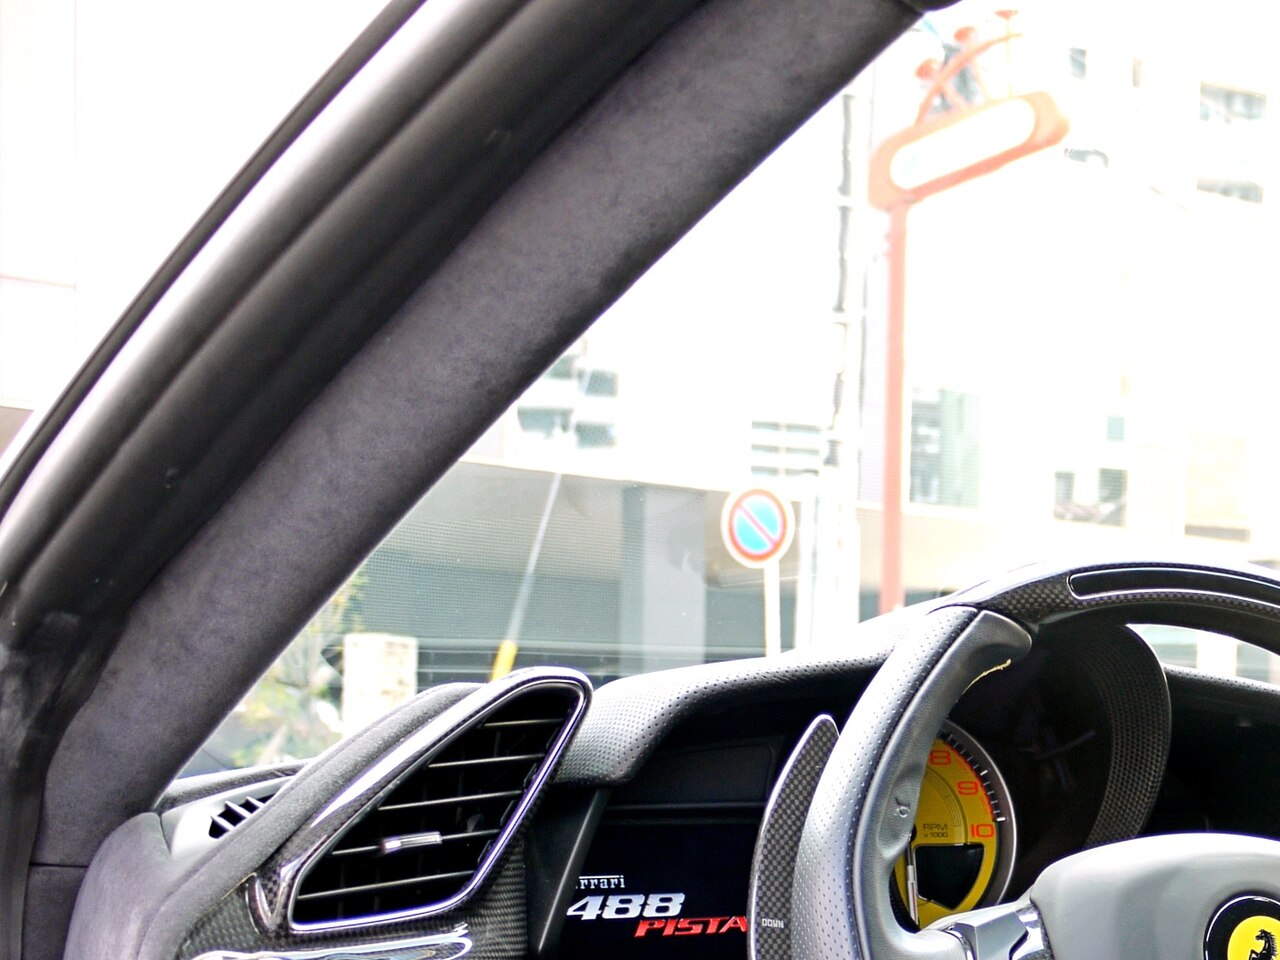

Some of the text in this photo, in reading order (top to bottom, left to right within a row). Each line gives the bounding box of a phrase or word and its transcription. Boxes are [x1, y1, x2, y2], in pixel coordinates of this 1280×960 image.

[929, 749, 952, 766] 8
[957, 781, 979, 796] 9
[922, 823, 949, 832] RPM
[970, 823, 996, 838] 10
[575, 875, 626, 889] rrari
[566, 892, 686, 921] 488
[633, 915, 748, 938] PISTA
[761, 918, 785, 929] DOWN
